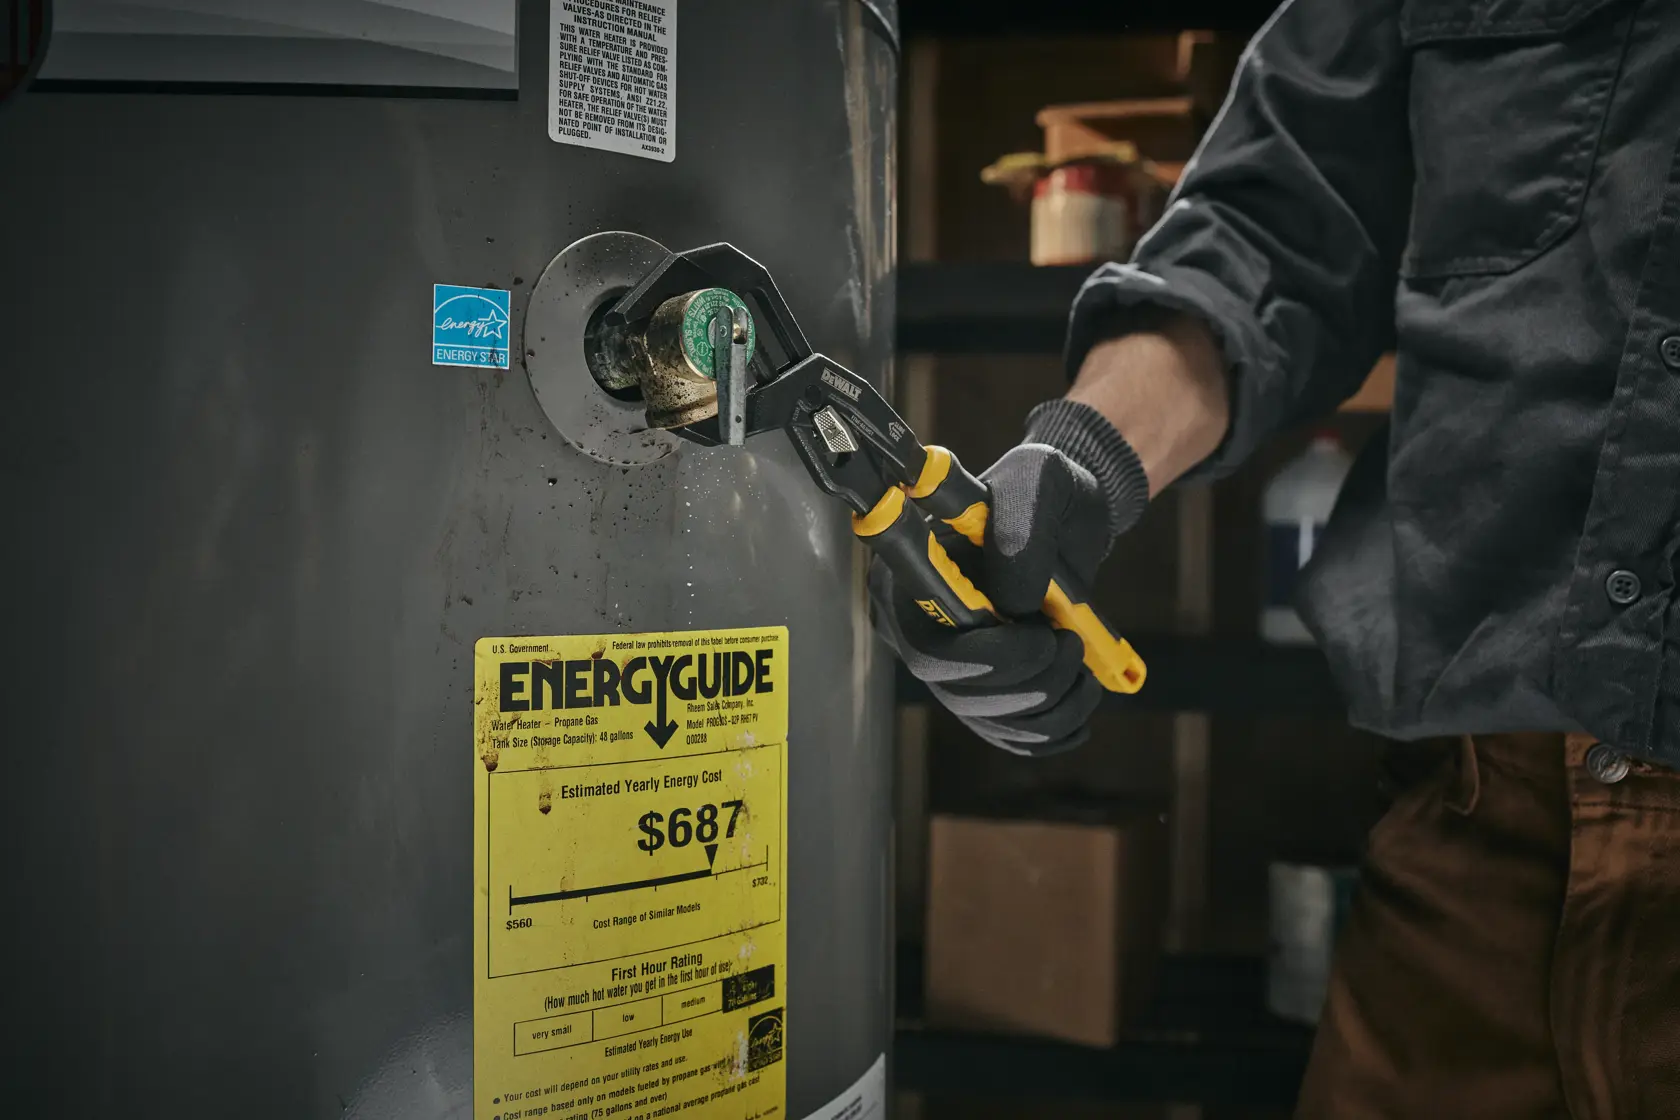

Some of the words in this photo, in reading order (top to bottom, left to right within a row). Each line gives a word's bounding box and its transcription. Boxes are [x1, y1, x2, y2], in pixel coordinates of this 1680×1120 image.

[563, 2, 604, 19] VALVES-AS
[606, 13, 642, 28] DIRECTED
[644, 23, 652, 31] IN
[654, 24, 666, 36] THE
[574, 14, 624, 34] INSTRUCTION
[626, 28, 656, 42] MANUAL
[622, 8, 636, 18] FOR
[638, 12, 662, 24] RELIEF
[560, 23, 576, 33] THIS
[578, 26, 600, 39] WATER
[604, 33, 626, 45] HEATER
[630, 39, 636, 47] IS
[640, 41, 668, 55] PROVIDED
[560, 32, 577, 43] WITH
[588, 38, 632, 55] TEMPERATURE
[636, 50, 648, 58] AND
[651, 54, 668, 64] PRES-
[560, 42, 577, 52] SURE
[579, 46, 600, 56] RELIEF
[602, 50, 620, 62] VALVE
[622, 55, 642, 66] LISTED
[644, 60, 651, 69] AS
[652, 63, 668, 72] COM-
[560, 51, 582, 63] PLYING
[586, 56, 603, 67] WITH
[606, 60, 618, 70] THE
[622, 64, 653, 78] STANDARD
[656, 73, 668, 82] FOR
[560, 60, 582, 71] RELIEF
[582, 66, 606, 77] VALVES
[607, 70, 620, 80] AND
[621, 74, 655, 88] AUTOMATIC
[656, 82, 668, 91] GAS
[560, 70, 590, 82] SHUT-OFF
[592, 76, 618, 89] DEVICES
[620, 82, 632, 92] FOR
[634, 86, 646, 95] HOT
[648, 89, 668, 100] WATER
[559, 80, 585, 91] SUPPLY
[627, 93, 642, 103] ANSI
[559, 89, 572, 98] FOR
[574, 92, 590, 102] SAFE
[591, 95, 625, 109] OPERATION
[626, 102, 634, 110] OF
[636, 104, 646, 113] THE
[648, 107, 667, 118] WATER
[559, 108, 572, 117] NOT
[574, 110, 582, 119] BE
[585, 113, 615, 125] REMOVED
[618, 119, 634, 129] FROM
[636, 123, 645, 131] ITS
[648, 125, 667, 136] DESIG-
[588, 103, 599, 113] THE
[601, 106, 622, 117] RELIEF
[623, 111, 650, 124] VALVE(S)
[651, 116, 667, 127] MUST
[559, 118, 579, 128] NATED
[583, 122, 602, 132] POINT
[604, 125, 613, 134] OF
[615, 128, 656, 142] INSTALLATION
[659, 137, 667, 146] OR
[436, 348, 478, 362] ENERGY
[480, 351, 506, 364] STAR
[492, 644, 506, 654] U.S.
[510, 644, 549, 653] Government
[612, 640, 634, 650] Federal
[636, 640, 646, 649] law
[648, 639, 671, 650] prohibits
[672, 638, 693, 647] removal
[694, 637, 700, 646] of
[687, 702, 705, 712] Rheem
[492, 720, 513, 731] Water
[517, 720, 540, 730] Heater
[554, 717, 583, 729] Propane
[585, 715, 599, 725] Gas
[687, 719, 704, 730] Model
[492, 738, 510, 749] Tank
[513, 737, 528, 748] Size
[531, 736, 561, 749] (Storage
[600, 732, 607, 741] 48
[610, 731, 633, 743] gallons
[561, 780, 620, 799] Estimated
[624, 777, 660, 793] Yearly
[664, 774, 698, 789] Energy
[702, 769, 722, 783] Cost
[637, 799, 743, 857] $687
[506, 918, 533, 930] $560
[593, 918, 610, 929] Cost
[613, 915, 637, 926] Range
[639, 912, 647, 922] of
[649, 908, 675, 920] Similar
[676, 902, 701, 915] Models
[612, 964, 637, 981] First
[641, 961, 667, 976] Hour
[671, 953, 703, 970] Rating
[544, 996, 565, 1012] (How
[568, 989, 590, 1007] much
[592, 987, 605, 1002] hot
[607, 984, 628, 999] water
[630, 982, 643, 997] you
[645, 979, 657, 994] get
[658, 977, 665, 988] in
[667, 973, 678, 987] the
[680, 969, 693, 984] first
[694, 966, 709, 981] hour
[710, 962, 717, 976] of
[681, 996, 706, 1009] medium
[622, 1013, 634, 1022] low
[532, 1030, 549, 1040] very
[551, 1025, 572, 1036] small
[605, 1041, 637, 1057] Estimated
[639, 1036, 658, 1049] Yearly
[660, 1031, 680, 1044] Energy
[682, 1027, 692, 1039] Use
[504, 1092, 523, 1102] Your
[525, 1088, 541, 1099] cost
[544, 1084, 558, 1096] will
[561, 1078, 588, 1095] depend
[591, 1076, 600, 1085] on
[602, 1072, 619, 1084] your
[621, 1066, 640, 1079] utility
[642, 1062, 659, 1072] rates
[661, 1057, 672, 1068] and
[674, 1055, 688, 1065] use.
[503, 1111, 521, 1120] Cost
[524, 1106, 548, 1116] range
[551, 1099, 574, 1112] based
[577, 1094, 594, 1107] only
[596, 1093, 606, 1101] on
[608, 1085, 635, 1099] models
[637, 1079, 659, 1091] fueled
[661, 1077, 670, 1086] by
[672, 1068, 698, 1084] propane
[591, 1108, 603, 1119] (75
[606, 1102, 632, 1116] gallons
[635, 1096, 648, 1108] and
[650, 1092, 667, 1104] over)
[652, 1103, 680, 1118] national
[683, 1094, 708, 1109] average
